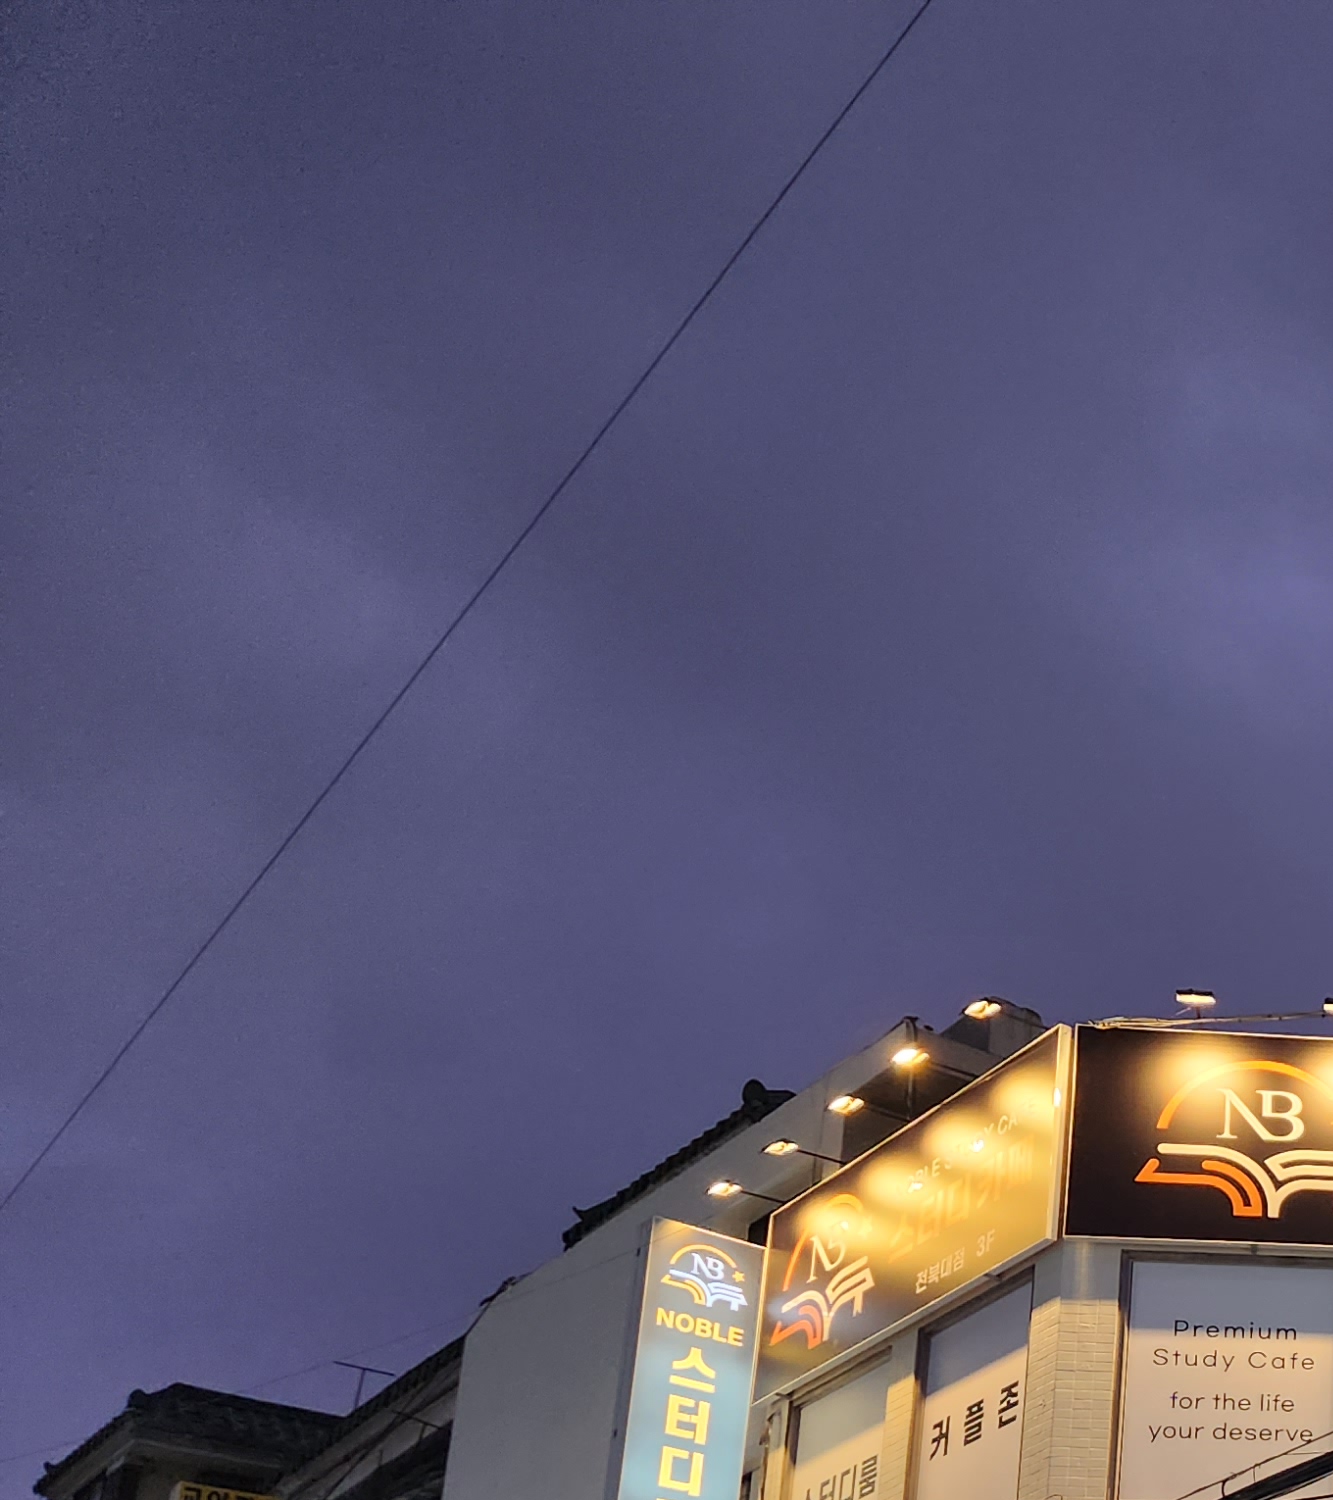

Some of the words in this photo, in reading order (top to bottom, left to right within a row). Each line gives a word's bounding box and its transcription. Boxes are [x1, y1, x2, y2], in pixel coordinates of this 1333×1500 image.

[976, 1229, 995, 1259] 3F
[656, 1306, 744, 1348] NOBLE
[1173, 1320, 1298, 1341] Premium
[1153, 1349, 1235, 1373] Study
[1248, 1351, 1315, 1371] Cafe
[1170, 1390, 1204, 1412] for
[1213, 1392, 1250, 1412] the
[1260, 1394, 1294, 1413] life
[1148, 1420, 1202, 1445] your
[1213, 1422, 1313, 1443] deserve
